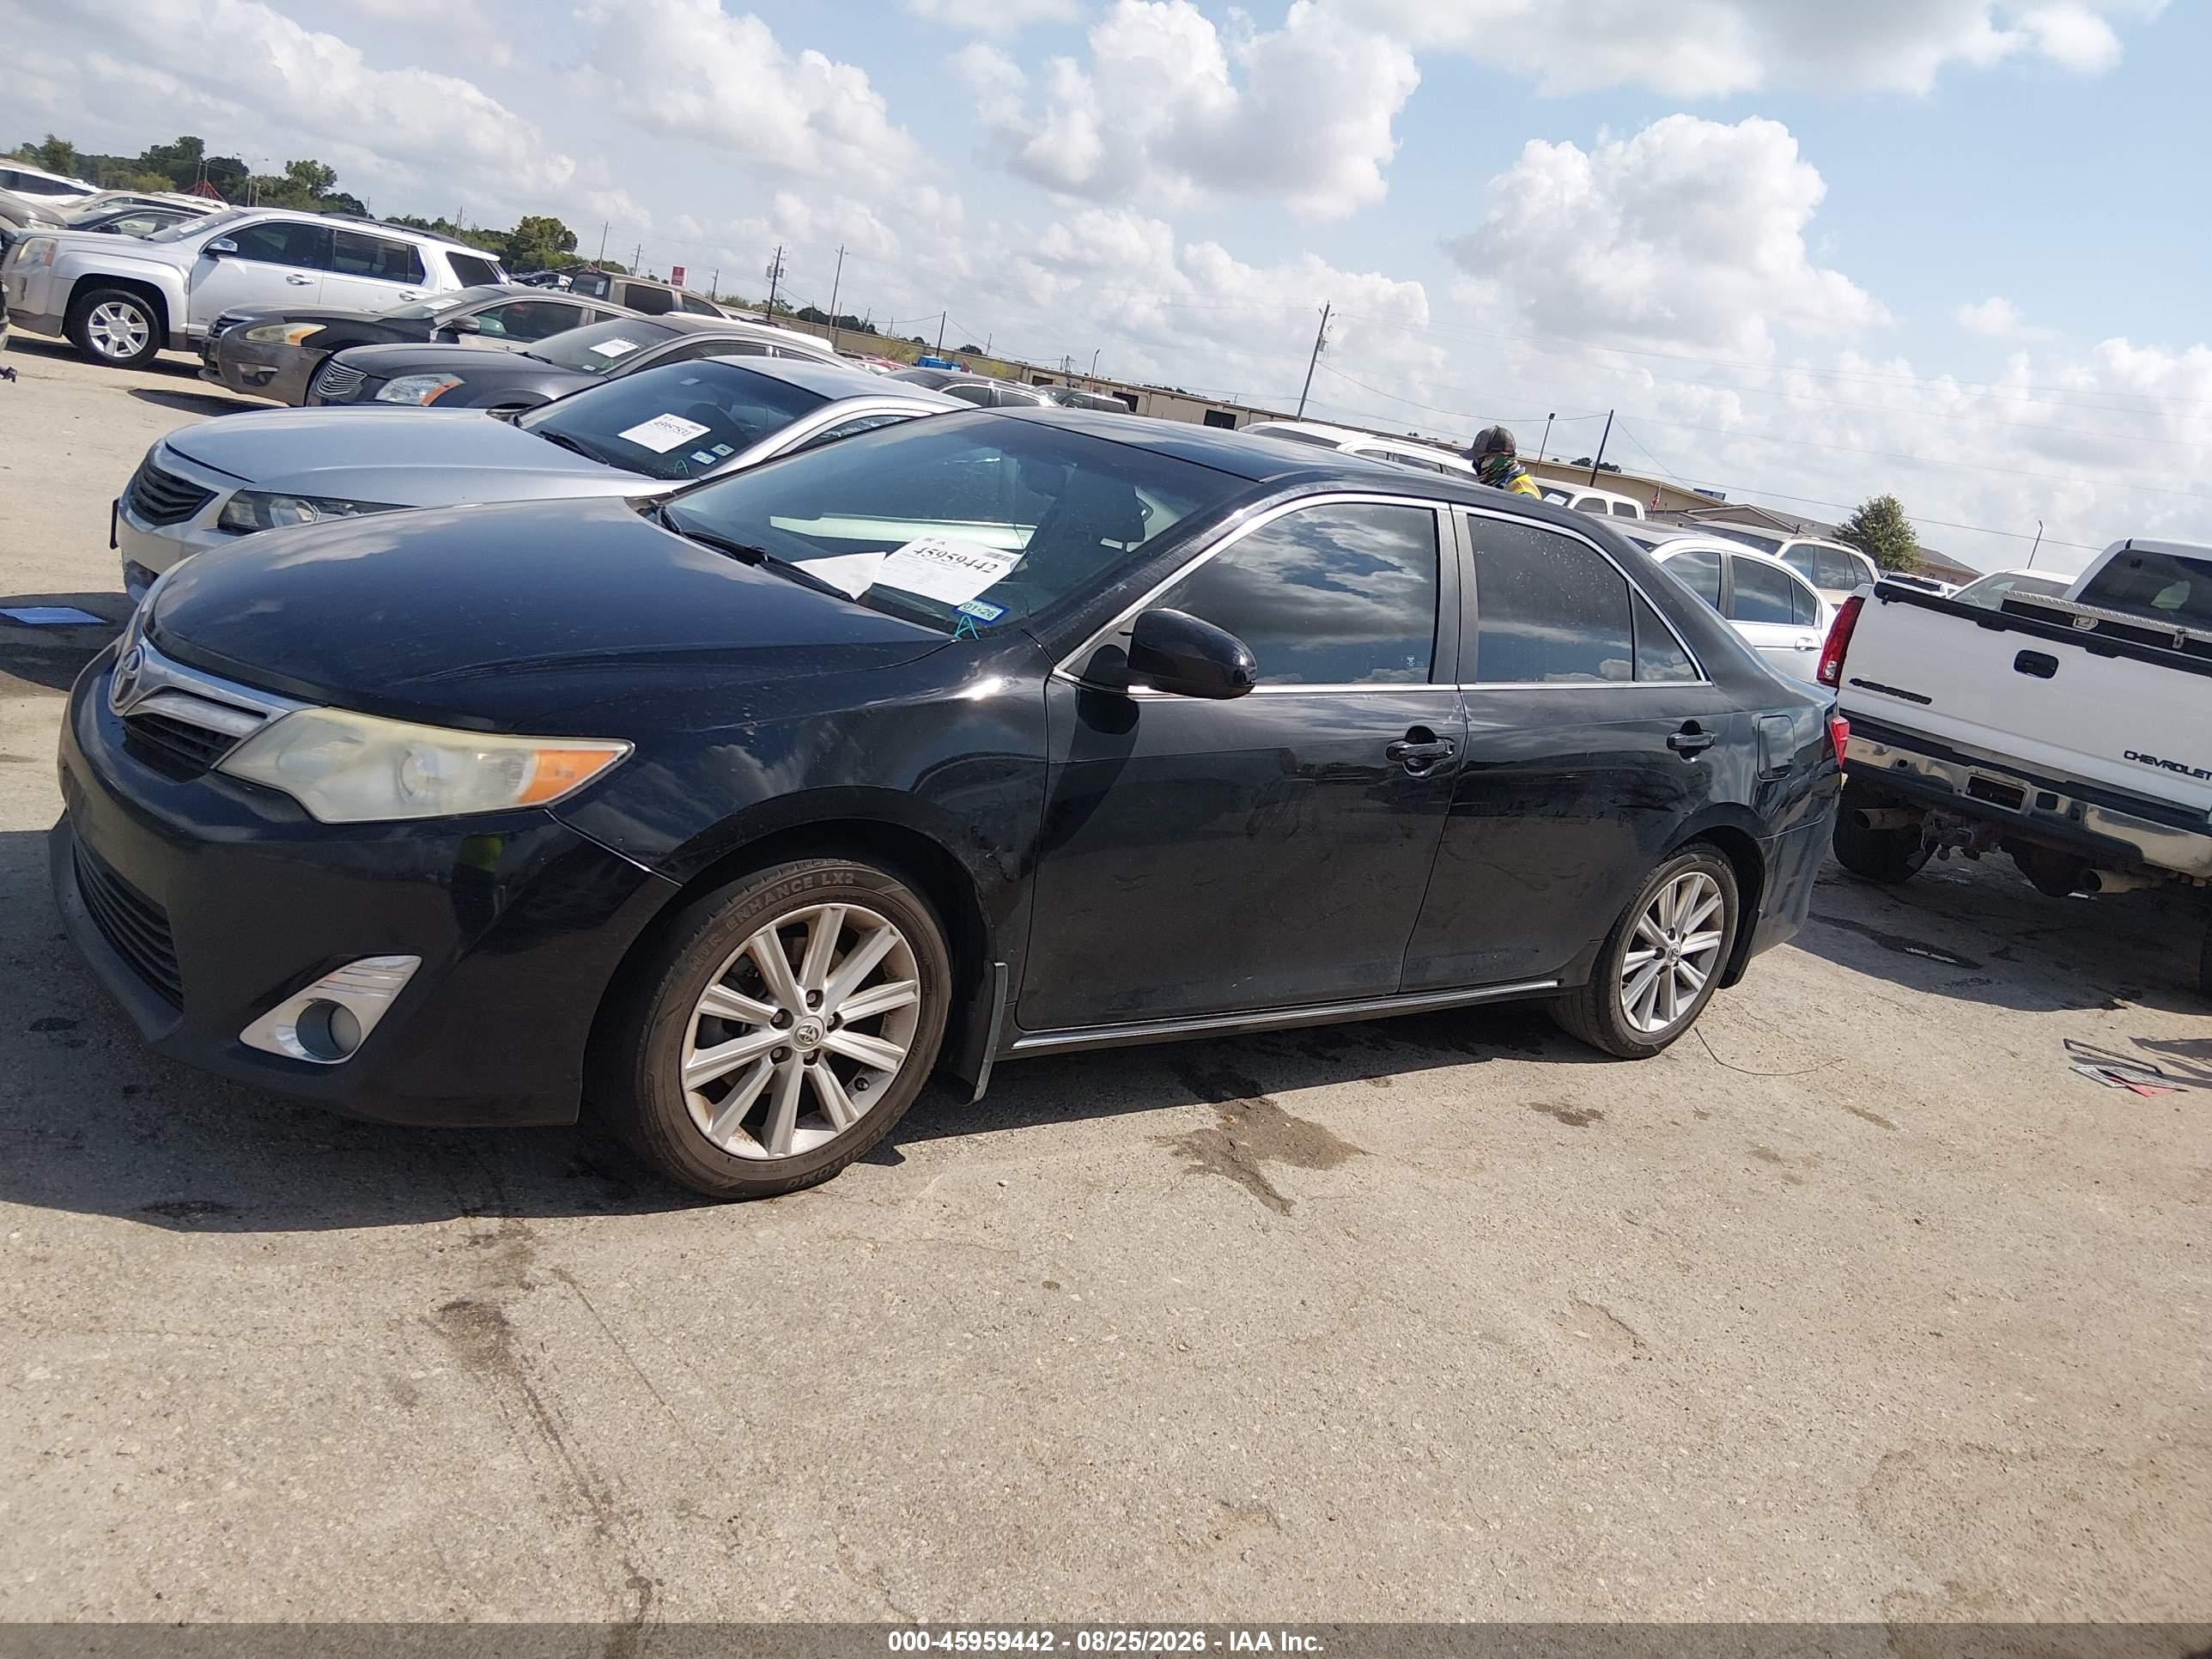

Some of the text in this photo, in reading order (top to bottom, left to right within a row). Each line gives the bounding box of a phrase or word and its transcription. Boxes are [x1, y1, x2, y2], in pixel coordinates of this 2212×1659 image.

[913, 547, 999, 574] 45959442
[954, 615, 980, 641] A
[2124, 750, 2212, 781] CHEVROLET
[821, 872, 855, 885] LX2
